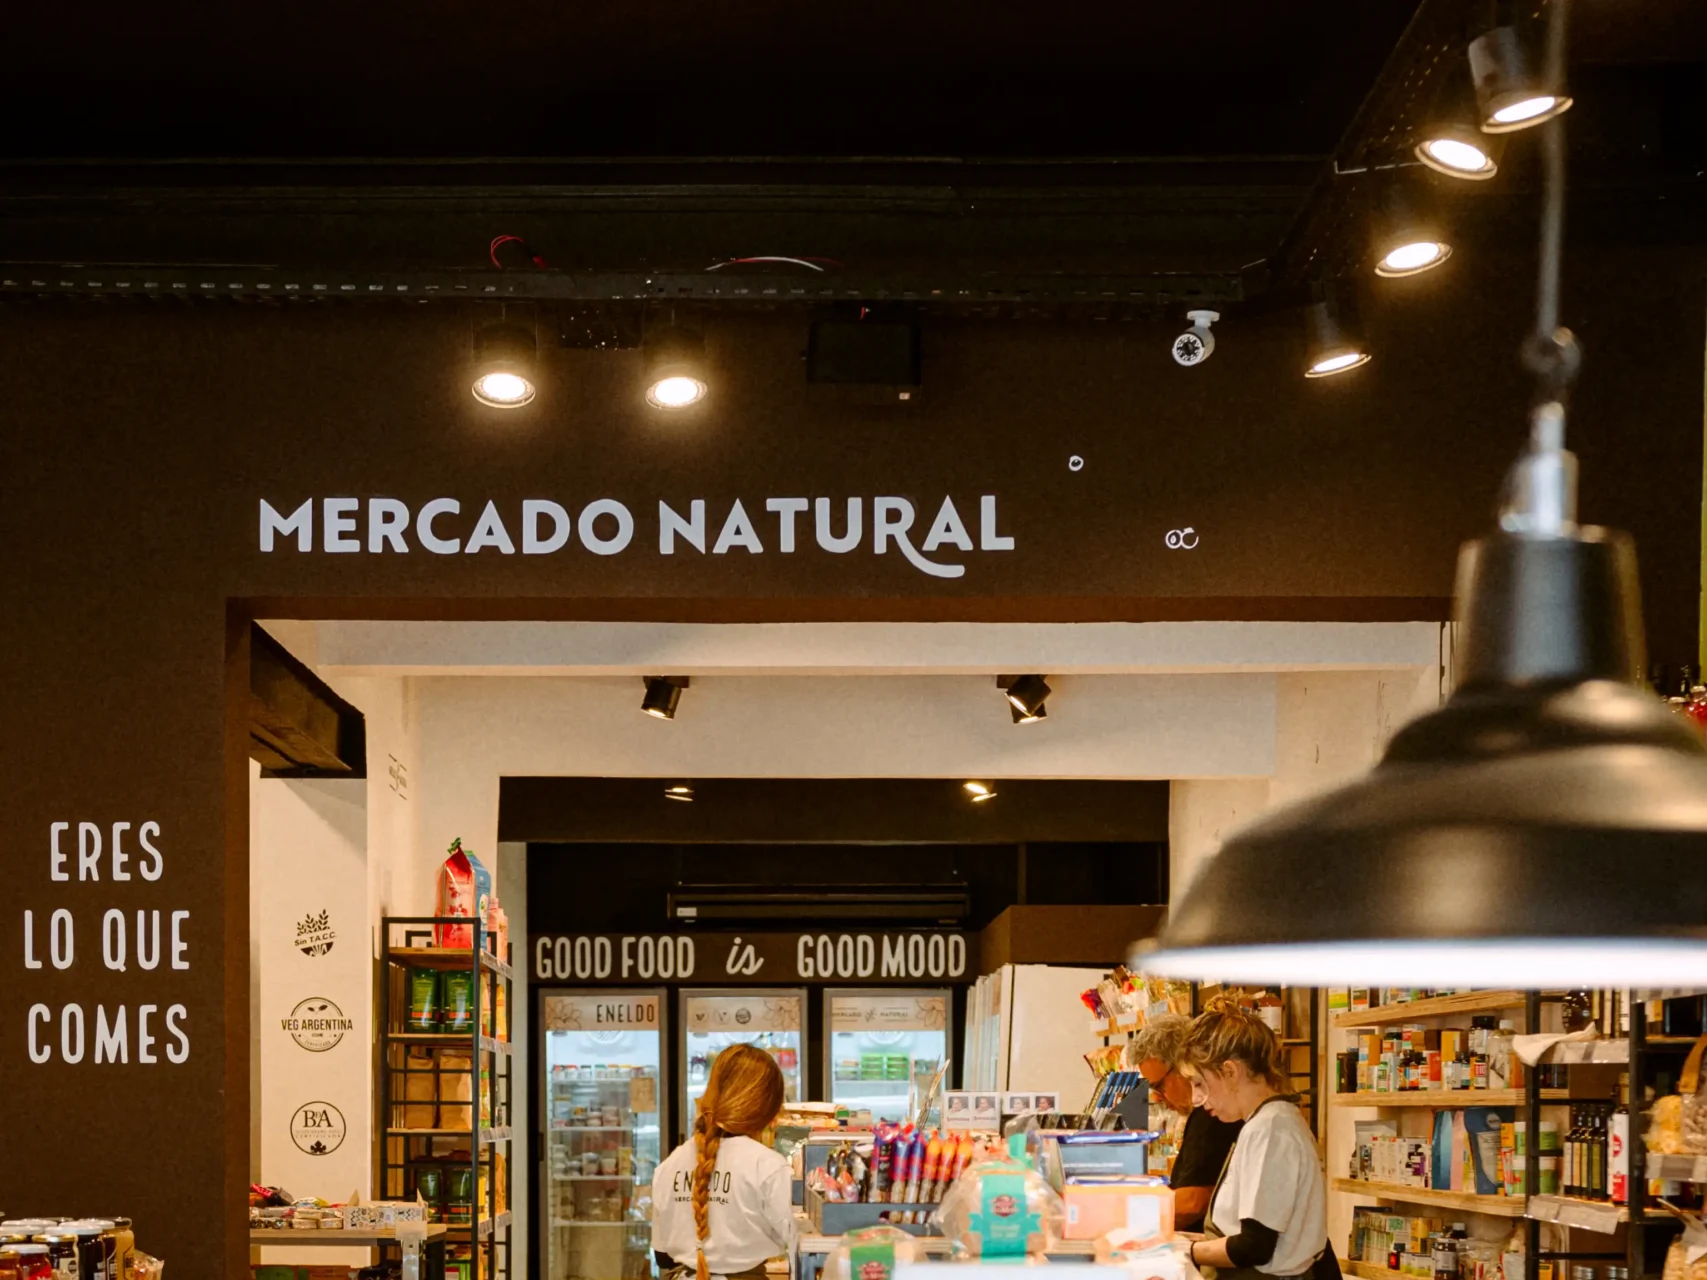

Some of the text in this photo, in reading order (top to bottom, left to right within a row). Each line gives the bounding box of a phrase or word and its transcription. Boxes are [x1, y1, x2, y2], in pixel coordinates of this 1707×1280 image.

[260, 494, 1015, 578] MERCADO NATURAL
[51, 821, 163, 881] ERES
[24, 908, 190, 973] LO QUE
[536, 934, 966, 979] GOOD FOOD is GOOD MOOD
[28, 1003, 190, 1064] COMES
[281, 1019, 353, 1030] VEG ARGENTINA
[596, 1004, 655, 1023] ENELDO
[673, 1170, 731, 1193] ENDO
